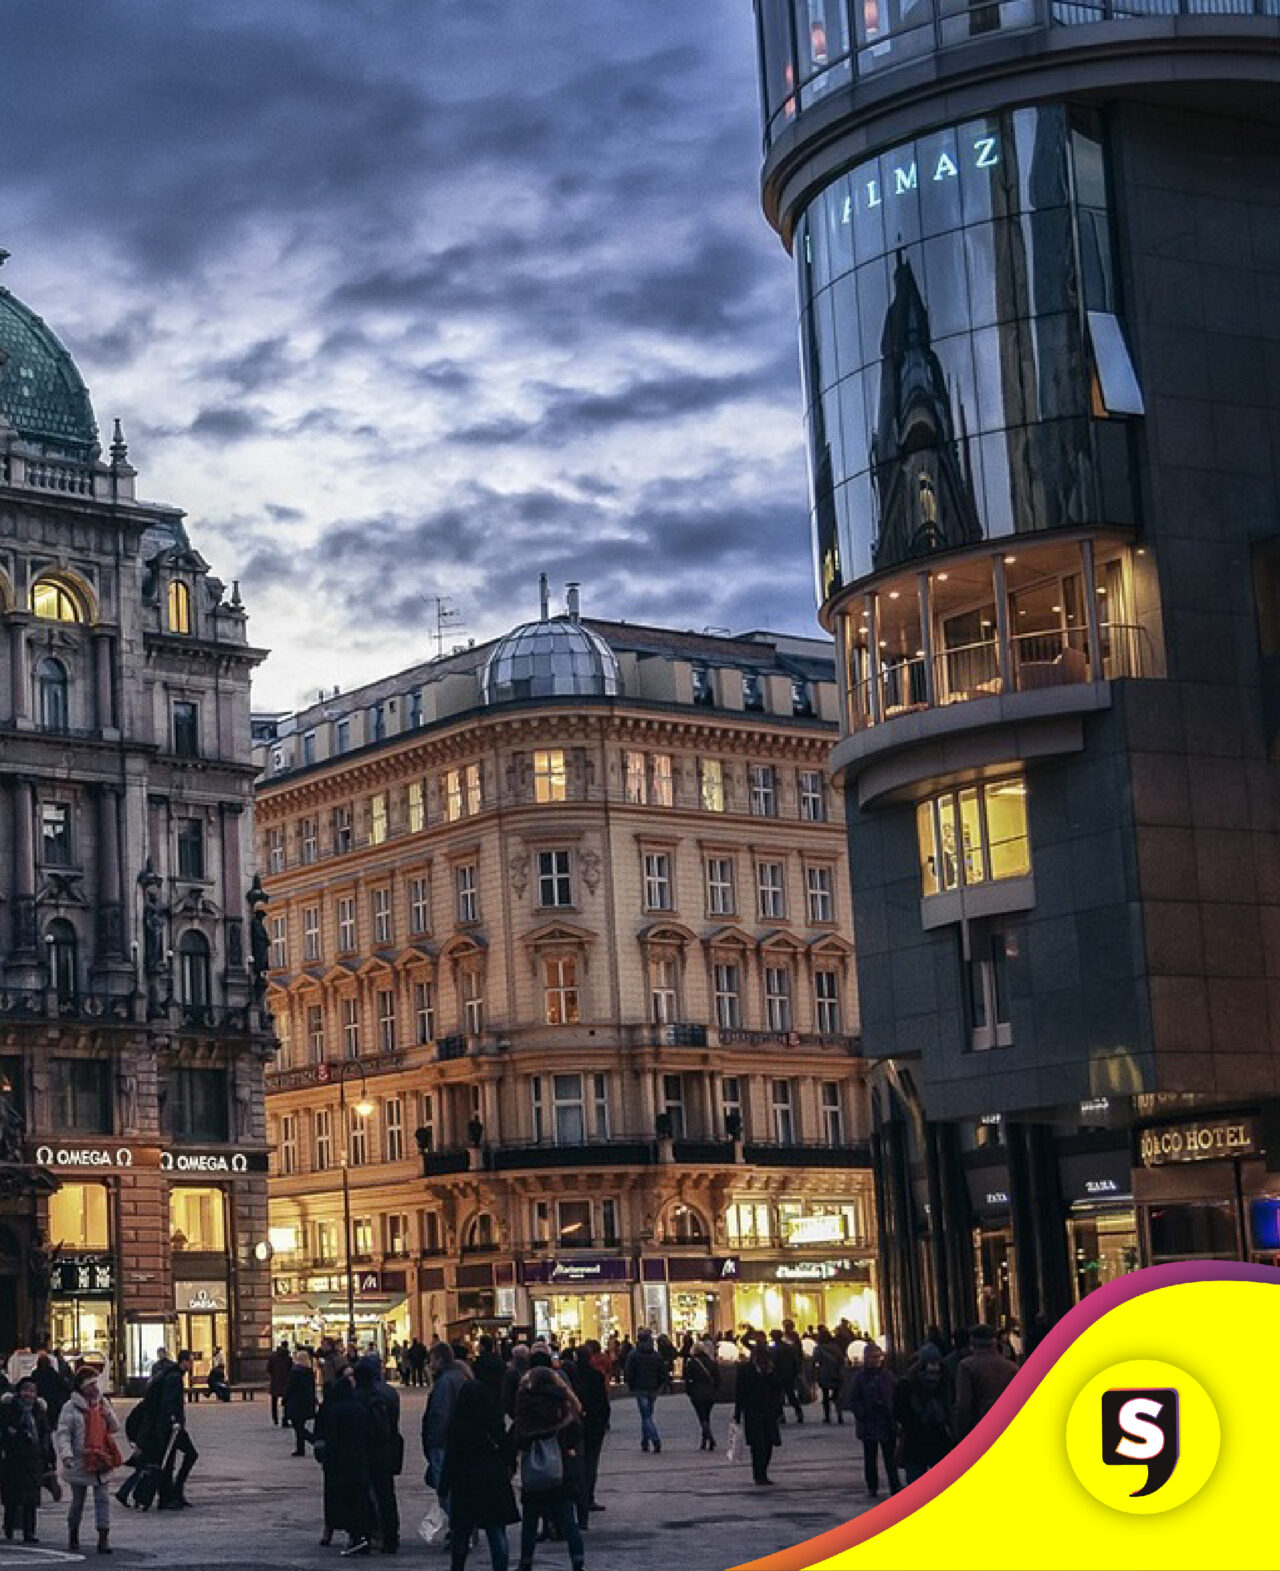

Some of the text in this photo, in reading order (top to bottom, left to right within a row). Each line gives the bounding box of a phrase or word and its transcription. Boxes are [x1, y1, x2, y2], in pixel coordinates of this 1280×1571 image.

[1186, 1125, 1251, 1151] HOTEL
[56, 1149, 112, 1166] OMEGA
[177, 1154, 229, 1171] OMEGA
